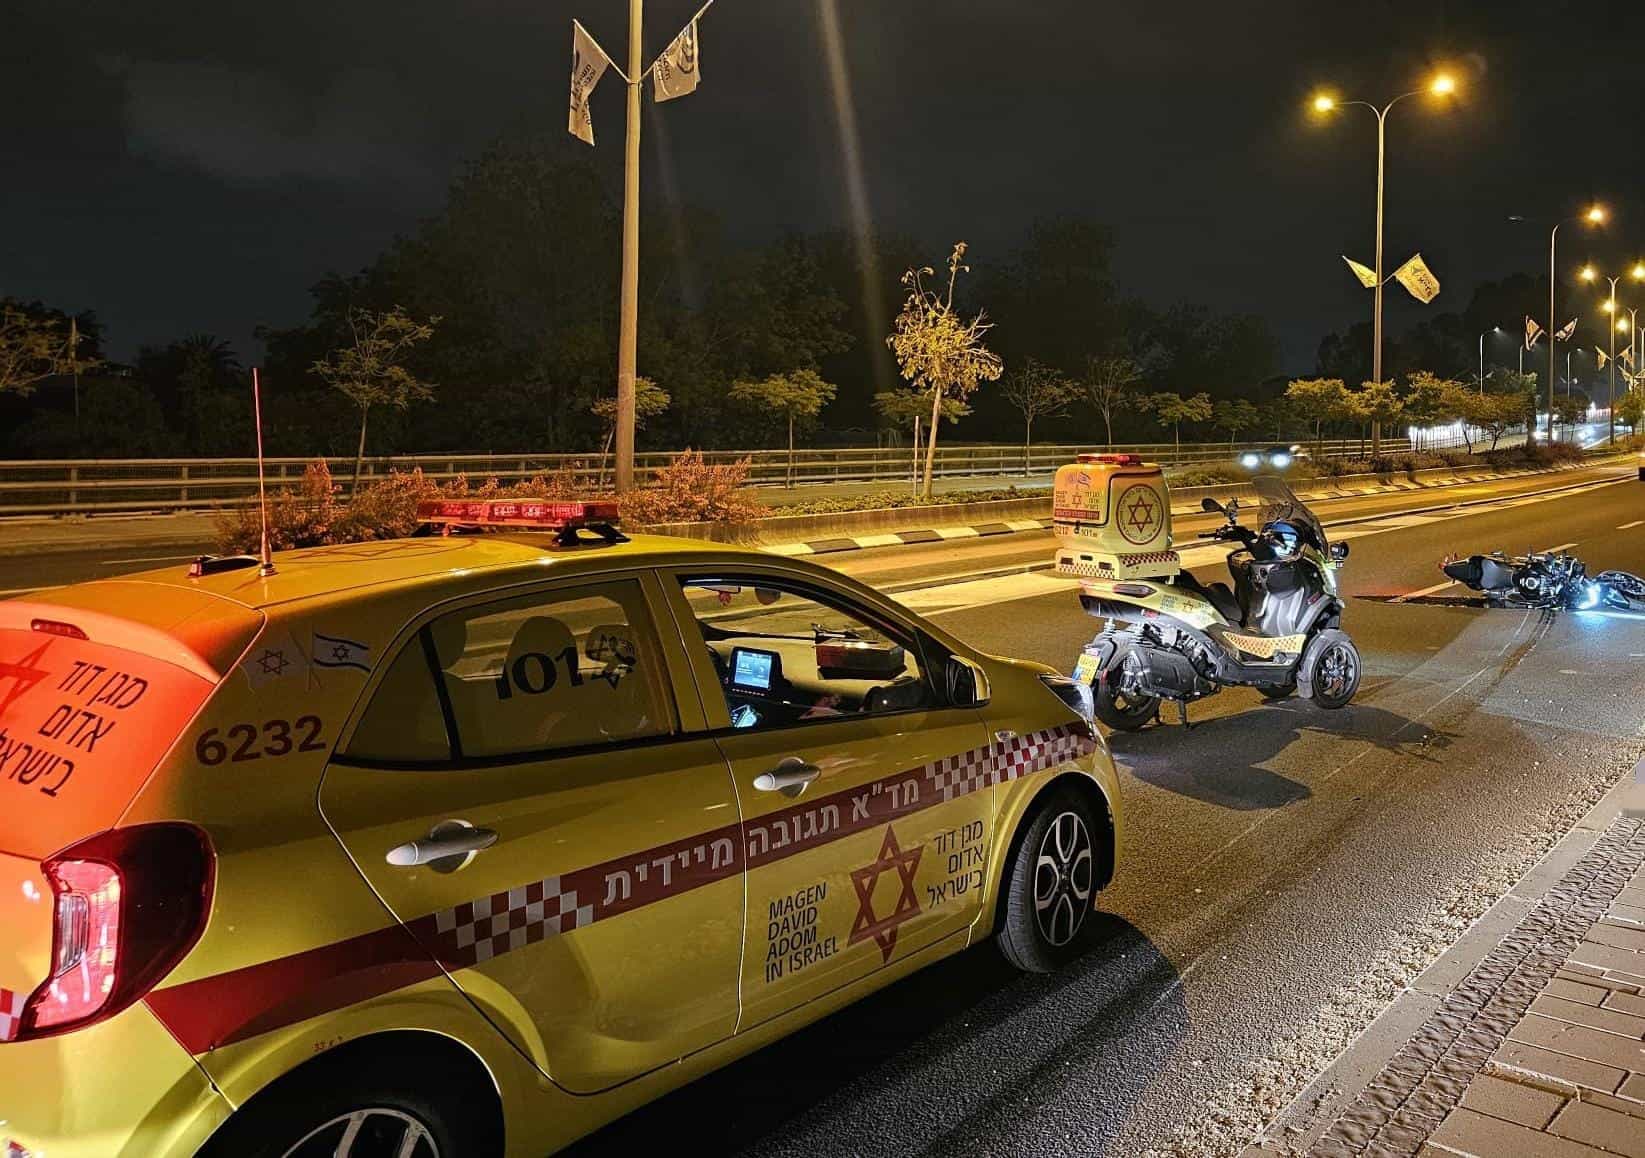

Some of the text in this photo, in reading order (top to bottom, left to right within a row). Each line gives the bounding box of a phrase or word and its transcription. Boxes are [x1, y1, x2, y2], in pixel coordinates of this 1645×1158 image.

[56, 660, 148, 710] מגן דוד
[495, 646, 585, 700] 101
[37, 704, 117, 753] אדום
[195, 715, 326, 767] 6232
[748, 803, 841, 858] תגובה
[933, 820, 984, 855] מגן דוד
[603, 837, 734, 906] מיידית
[947, 843, 984, 874] אדום
[769, 881, 827, 921] MAGEN
[926, 869, 984, 909] בישראל
[765, 926, 817, 963] ADOM
[768, 906, 818, 941] DAVID
[766, 936, 839, 983] IN ISRAEL
